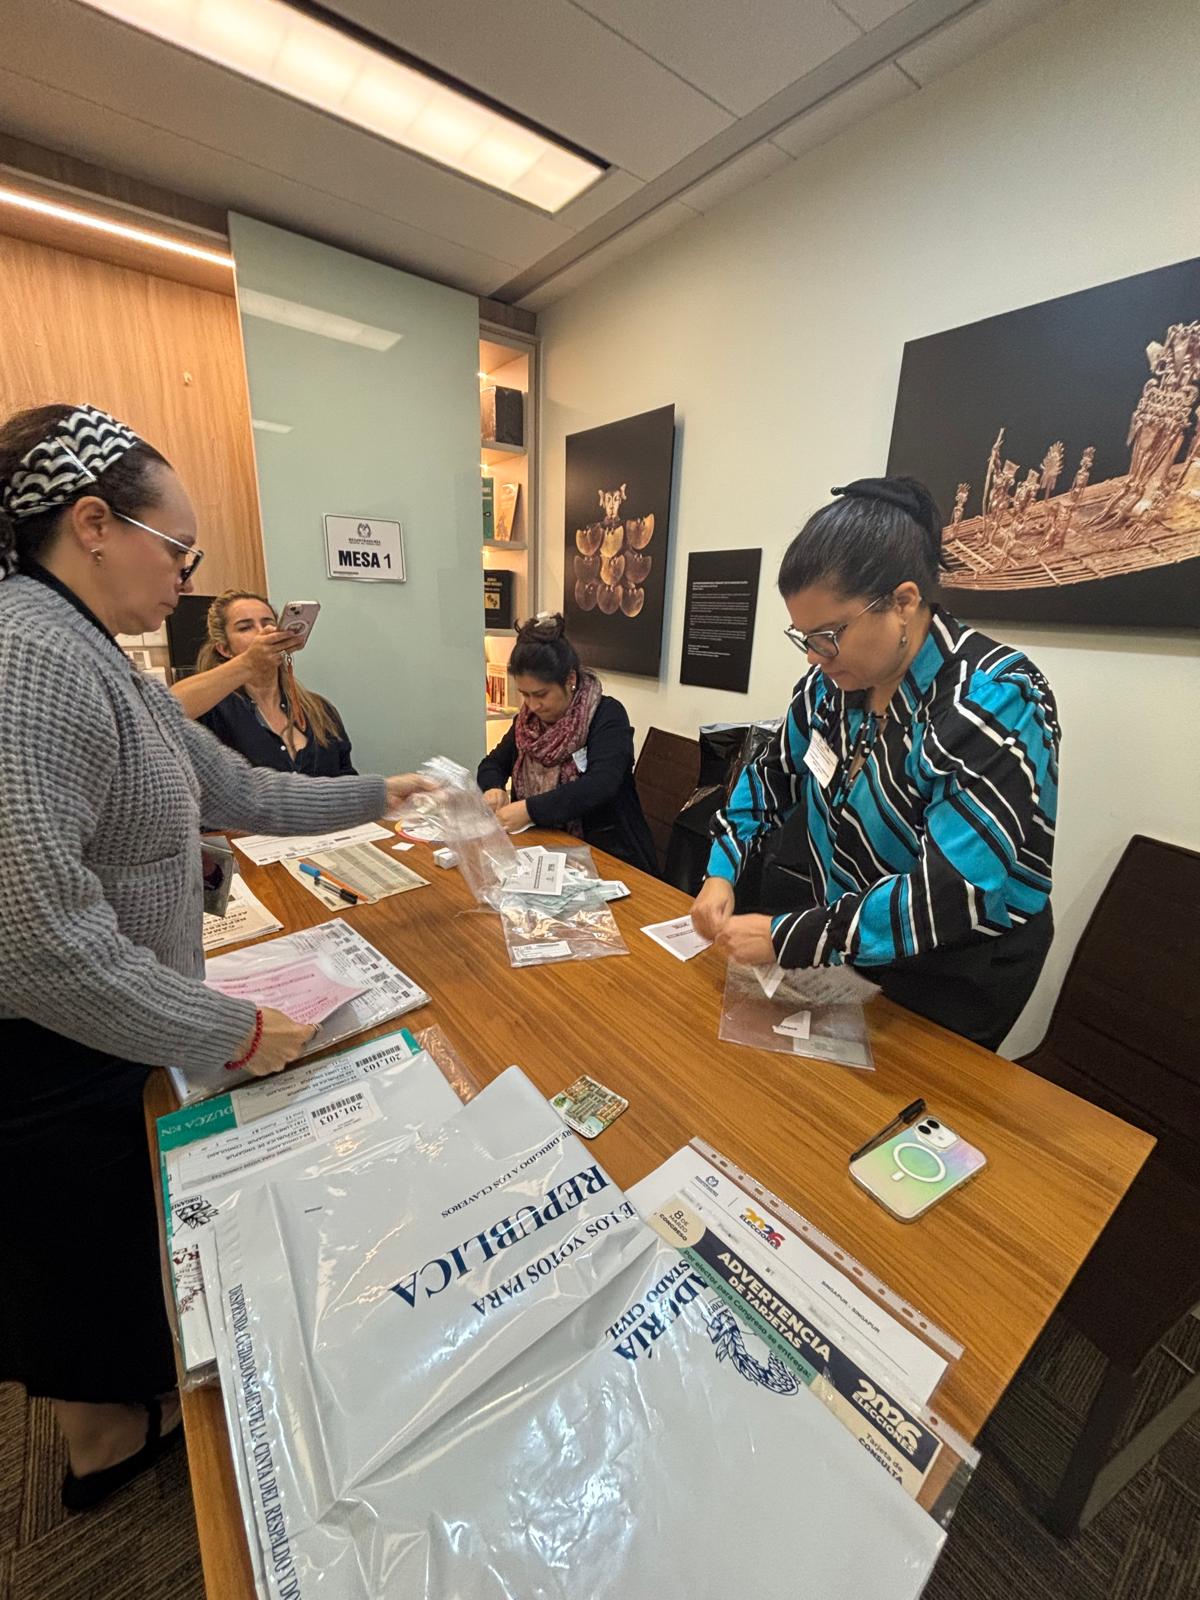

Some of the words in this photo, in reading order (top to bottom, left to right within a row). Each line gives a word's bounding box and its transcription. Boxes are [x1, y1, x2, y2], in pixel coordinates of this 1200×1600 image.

[338, 550, 381, 568] MESA
[383, 553, 391, 569] 1
[362, 1052, 401, 1072] 201.103
[184, 1105, 233, 1129] DUZCA
[318, 1101, 363, 1125] 201.103
[510, 1166, 520, 1175] A
[518, 1136, 560, 1170] DIRIGIDO
[492, 1172, 512, 1188] LOS
[440, 1185, 492, 1218] CLAVEROS
[616, 1199, 636, 1220] E
[673, 1209, 683, 1220] 8
[679, 1217, 690, 1227] DE
[387, 1164, 609, 1309] REPUBLICA
[584, 1211, 619, 1239] LOS
[658, 1212, 688, 1241] CONGRESO
[668, 1214, 687, 1233] MARZO
[738, 1213, 779, 1250] ELECCIONES
[746, 1207, 785, 1249] 2026
[523, 1233, 585, 1284] VOTOS
[470, 1272, 526, 1316] PARA
[644, 1258, 690, 1303] STADO
[604, 1302, 646, 1339] CIVIL
[612, 1269, 709, 1362] ADURÍA
[682, 1249, 696, 1262] Por
[694, 1260, 718, 1284] elector
[716, 1282, 734, 1301] para
[732, 1298, 768, 1336] Congreso
[766, 1333, 778, 1345] se
[776, 1343, 812, 1379] entrega:
[716, 1253, 828, 1361] ADVERTENCIA
[727, 1275, 746, 1294] DE
[744, 1292, 802, 1348] TARJETAS
[820, 1280, 848, 1305] SINGAPUR
[850, 1307, 880, 1334] SINGAPUR
[851, 1392, 916, 1456] ELECCIONES
[857, 1379, 922, 1451] 2026
[252, 1442, 274, 1480] CINTA
[857, 1436, 903, 1485] CONSULTA
[864, 1433, 892, 1462] Tarjeta
[891, 1459, 904, 1473] de
[259, 1478, 279, 1506] DEL
[264, 1503, 292, 1572] RESPALDO
[277, 1566, 296, 1584] Y
[279, 1578, 301, 1600] DO
